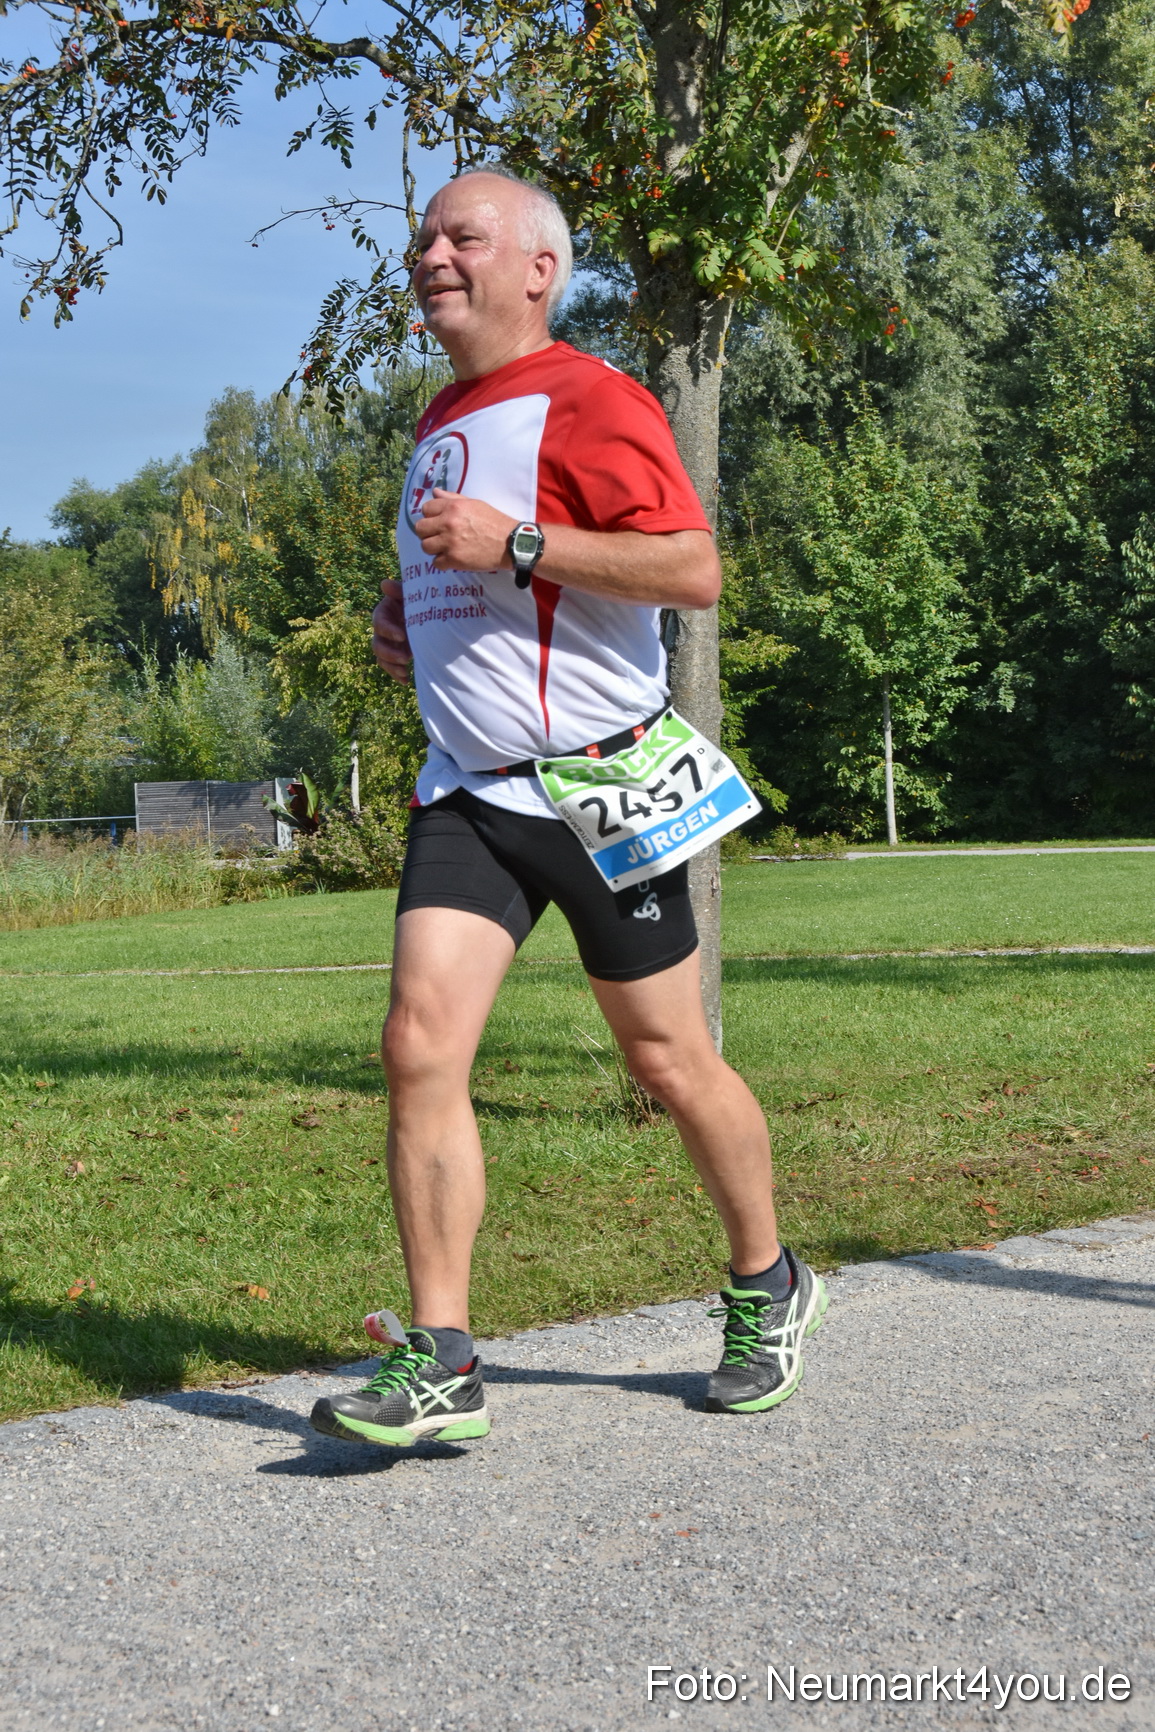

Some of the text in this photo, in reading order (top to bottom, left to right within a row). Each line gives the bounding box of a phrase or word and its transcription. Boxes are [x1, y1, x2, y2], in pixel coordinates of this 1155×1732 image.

[445, 584, 483, 597] Röschl
[578, 752, 704, 839] 2457
[627, 799, 720, 864] JÜRGEN
